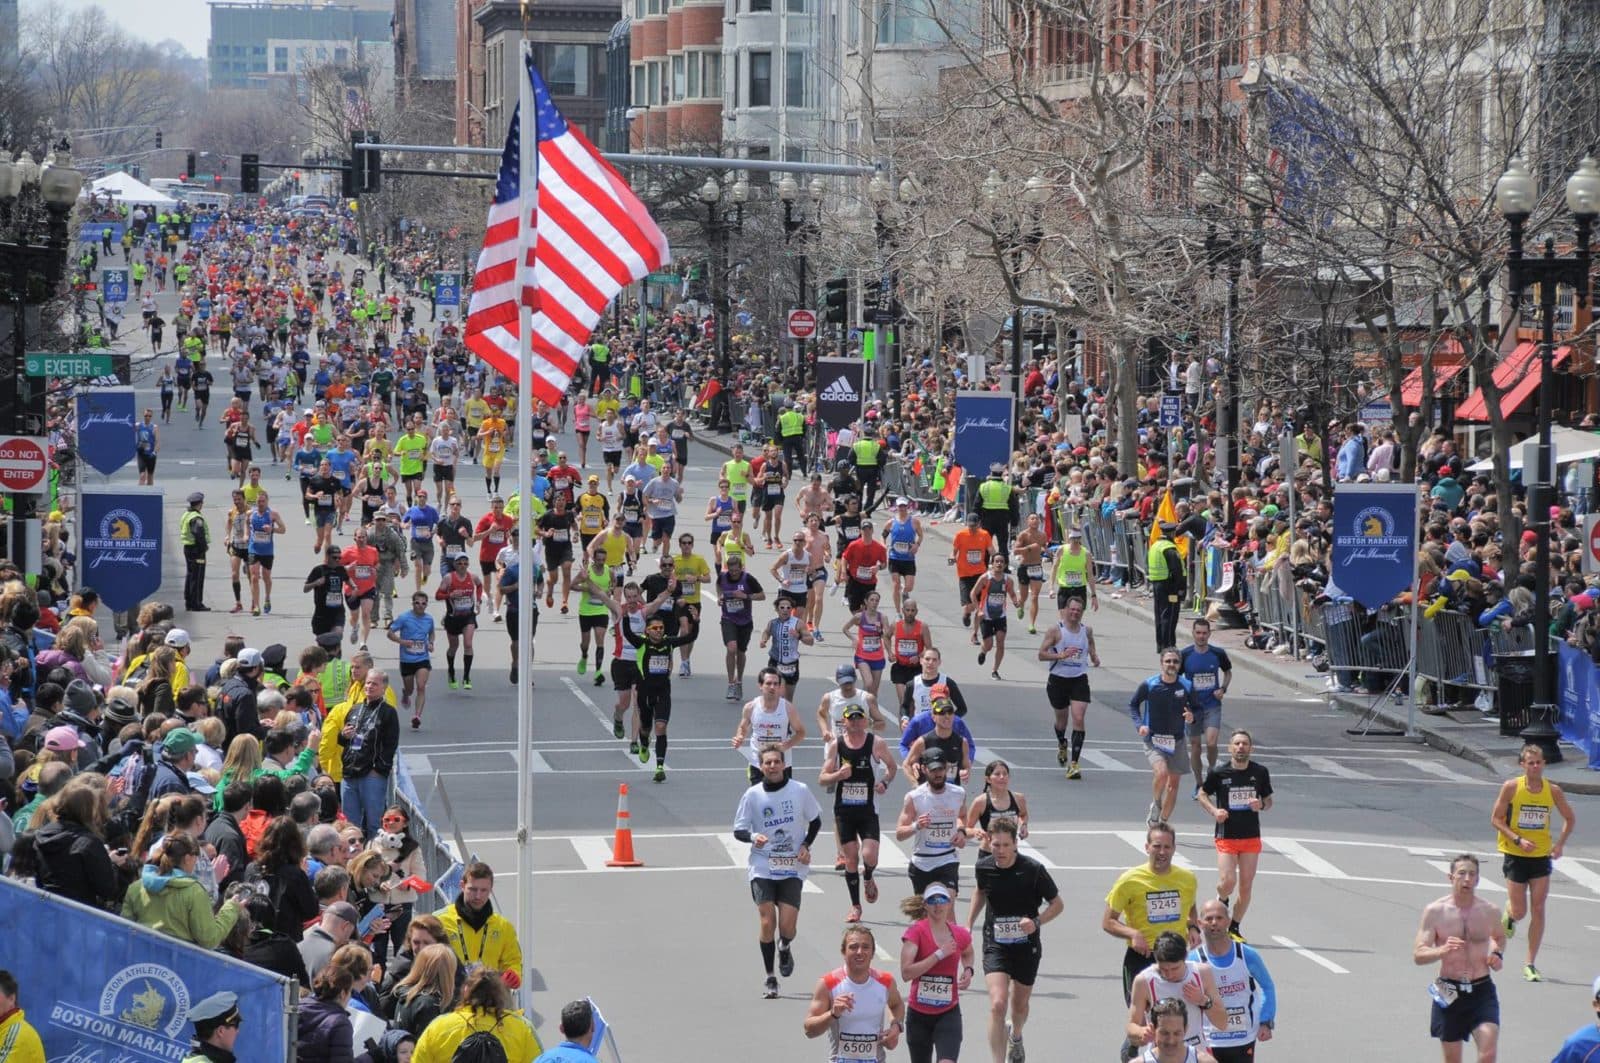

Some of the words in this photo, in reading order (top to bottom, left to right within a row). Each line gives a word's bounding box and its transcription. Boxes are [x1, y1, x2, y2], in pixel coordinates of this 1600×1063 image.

[108, 273, 123, 283] 26
[440, 277, 455, 286] 26
[45, 360, 91, 374] EXETER
[820, 391, 858, 402] adidas
[81, 413, 101, 430] John
[100, 411, 133, 427] Hancock
[957, 417, 979, 433] John
[979, 417, 1008, 432] Hancock
[0, 450, 15, 458] DO
[19, 450, 39, 459] NOT
[4, 470, 34, 479] ENTER
[115, 540, 157, 548] MARATHON
[89, 550, 114, 568] John
[114, 550, 149, 567] Hancock
[1342, 547, 1366, 566] John
[1366, 547, 1401, 564] Hancock
[764, 816, 794, 827] CARLOS
[773, 858, 795, 866] 5302
[1151, 899, 1177, 910] 5245
[923, 982, 949, 994] 5464
[103, 977, 124, 1011] BOSTON
[125, 966, 168, 979] ATHLETIC
[168, 976, 187, 1032] ASSOCIATION
[51, 1005, 116, 1038] BOSTON
[117, 1028, 187, 1062] MARATH
[843, 1042, 872, 1053] 6500
